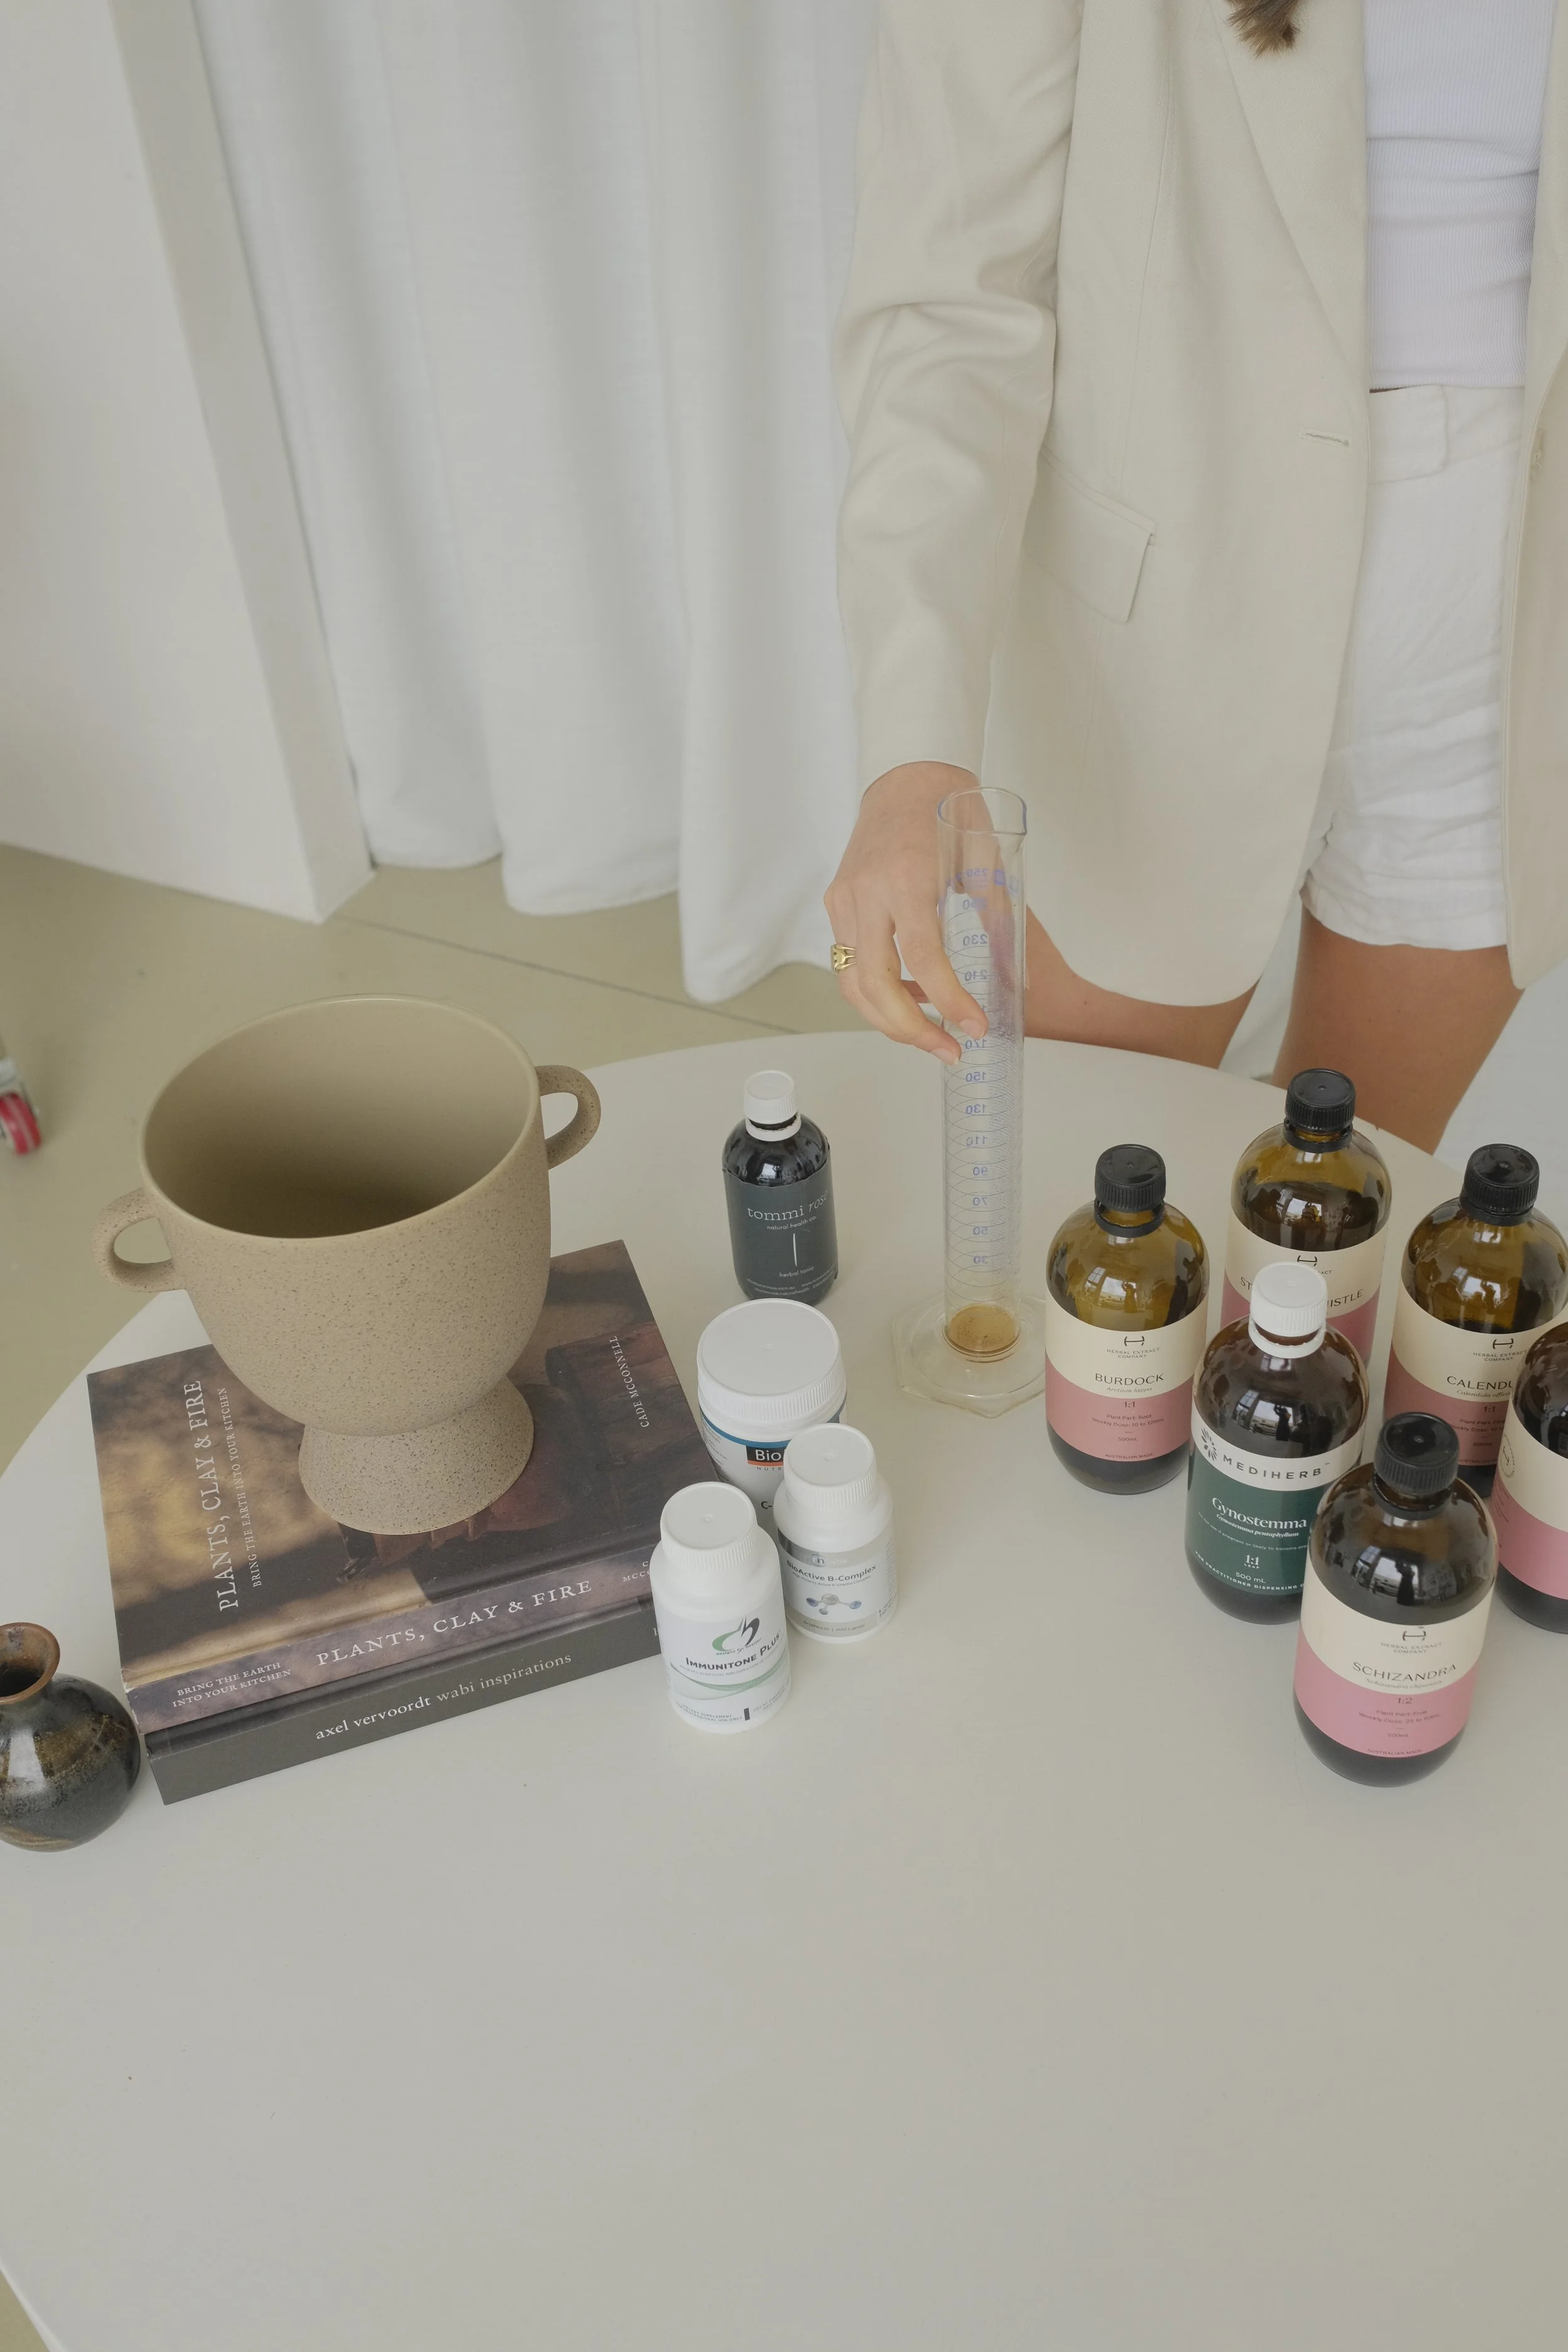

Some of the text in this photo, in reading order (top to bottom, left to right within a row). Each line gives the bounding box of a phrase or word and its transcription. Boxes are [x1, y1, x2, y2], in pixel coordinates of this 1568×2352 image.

[747, 1205, 804, 1221] tommi
[790, 1219, 808, 1228] health
[1327, 1288, 1364, 1308] ISTLE
[609, 1336, 650, 1428] CADE MCCONNELL
[1095, 1372, 1164, 1385] BURDOCK
[1091, 1417, 1112, 1426] Weekly
[755, 1449, 781, 1461] Bio
[1223, 1454, 1322, 1480] MEDIHERB
[184, 1380, 238, 1612] PLANTS, CLAY & FIRE
[218, 1387, 262, 1587] BRING THE EARTH INTO YOUR KITCHEN
[1212, 1497, 1308, 1529] Gynostemma
[1216, 1513, 1254, 1534] Gynostemma
[787, 1559, 877, 1582] BioActive B-Complex
[1195, 1551, 1204, 1562] FOR
[1205, 1562, 1251, 1587] PRACTITIONER
[1246, 1555, 1259, 1565] 1:1
[1236, 1572, 1251, 1581] 500
[315, 1581, 592, 1666] PLANTS, CLAY & FIRE
[177, 1662, 281, 1696] BRING THE EARTH
[1353, 1661, 1456, 1682] SCHIZANDRA
[172, 1669, 292, 1708] INTO YOUR KITCHEN
[315, 1654, 572, 1740] axel vervoordt wabi inspirations
[684, 1707, 717, 1722] PROFESSIONAL
